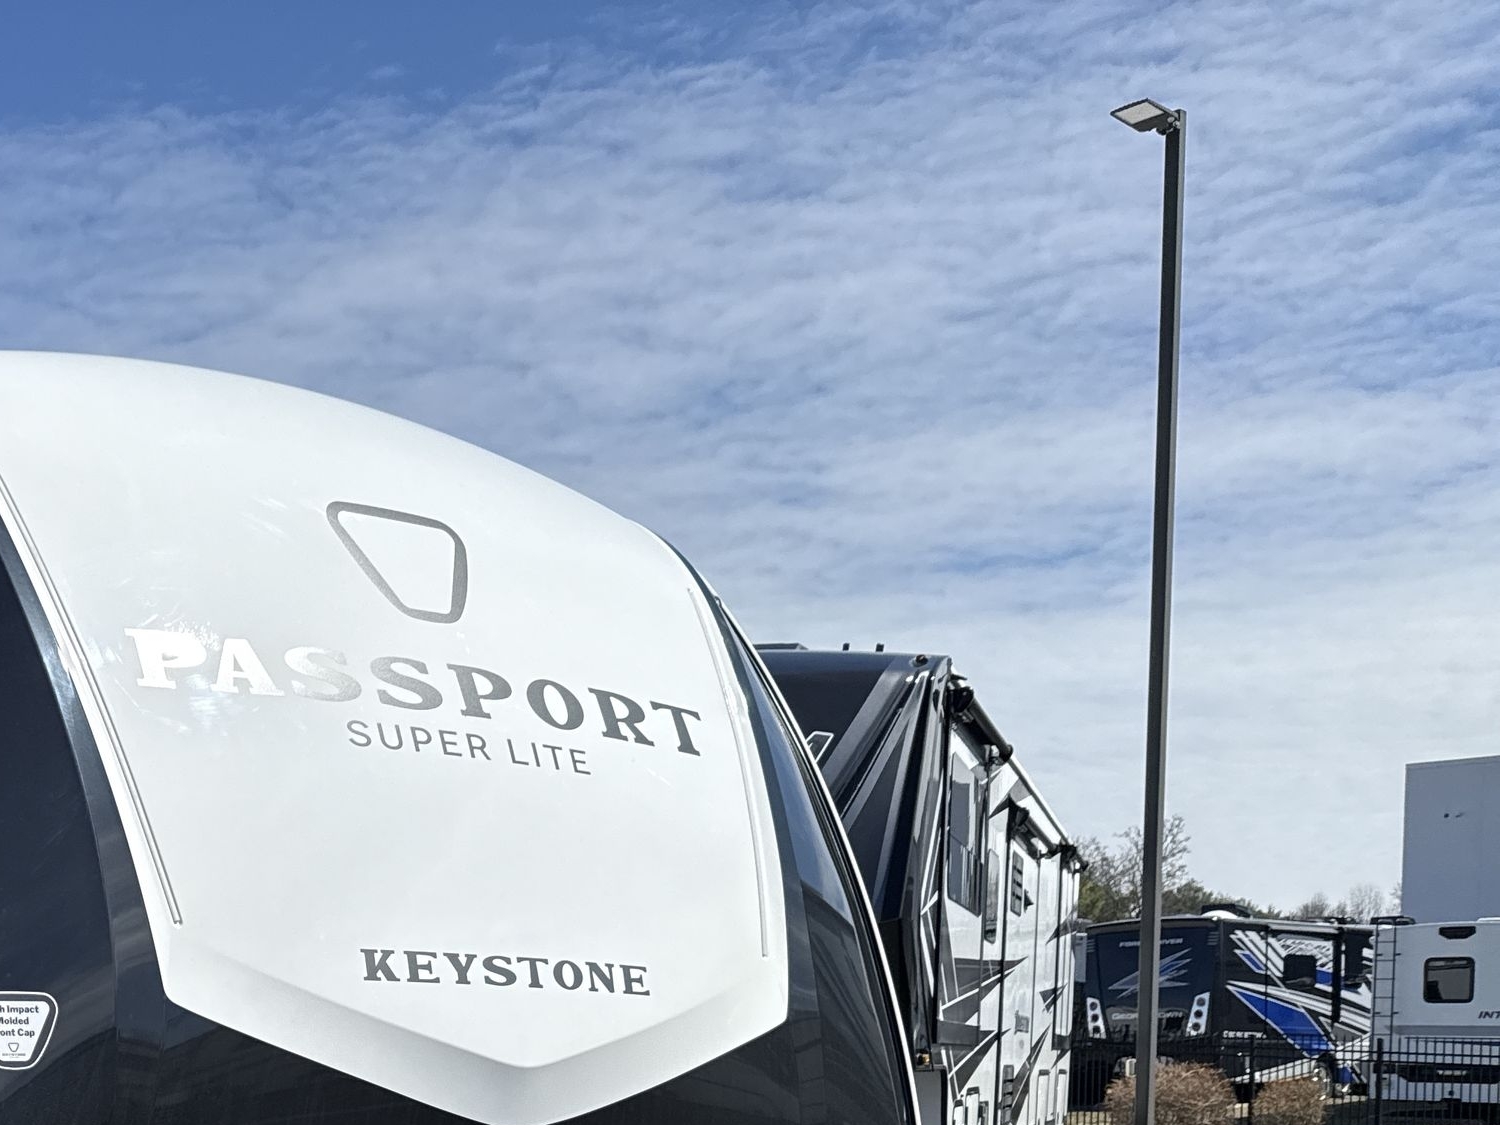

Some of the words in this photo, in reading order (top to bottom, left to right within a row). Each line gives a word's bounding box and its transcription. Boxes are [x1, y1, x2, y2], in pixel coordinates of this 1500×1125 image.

[123, 626, 702, 757] PASSPORT
[346, 719, 492, 761] SUPER
[506, 738, 592, 776] LITE
[360, 948, 650, 996] KEYSTONE
[7, 1004, 39, 1015] Impact
[17, 1028, 35, 1038] Cap
